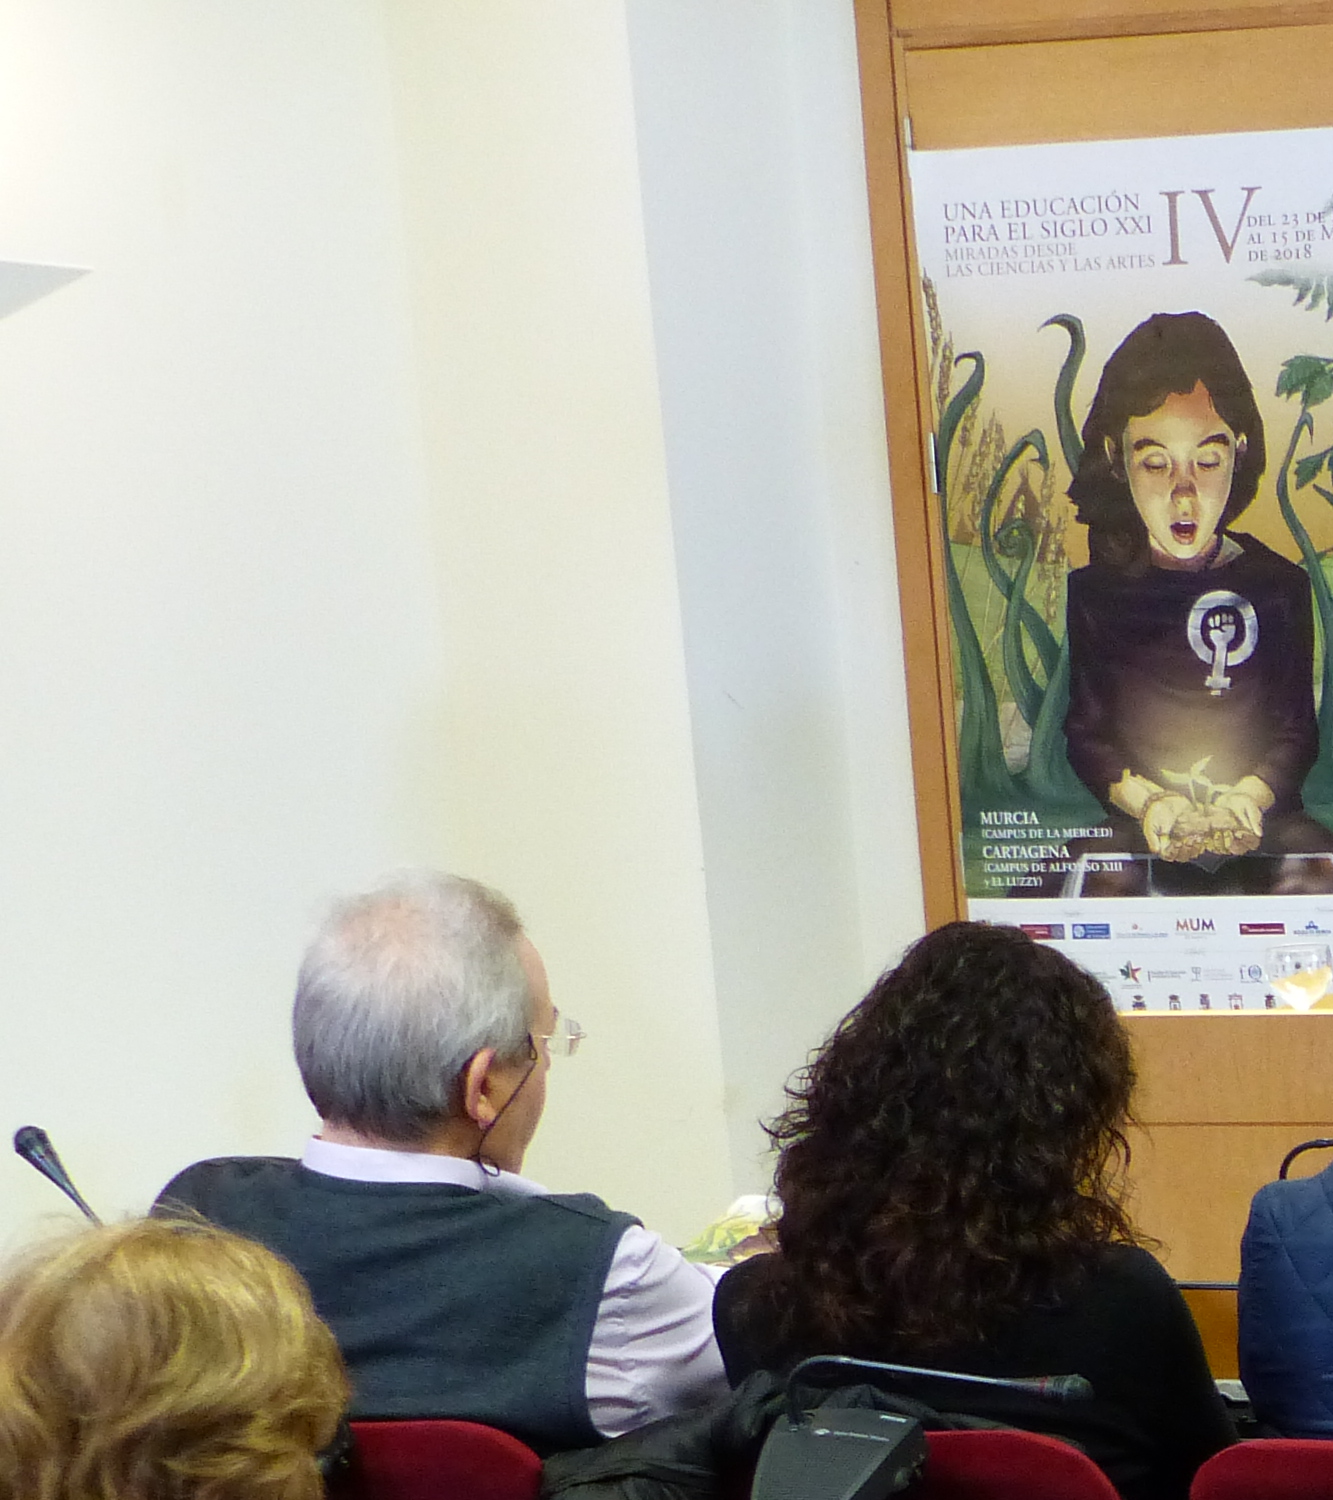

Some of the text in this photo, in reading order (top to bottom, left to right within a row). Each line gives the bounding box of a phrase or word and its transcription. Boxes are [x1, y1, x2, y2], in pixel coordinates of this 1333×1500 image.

[943, 190, 1140, 221] UNA EDUCACIÓN
[1159, 186, 1262, 265] IV
[1282, 213, 1300, 229] 23
[945, 215, 1153, 244] PARA EL SIGLO XXI
[1271, 231, 1288, 246] 15
[945, 242, 1077, 263] MIRADAS DESDE
[1274, 243, 1313, 261] 2018
[946, 254, 1156, 278] LAS CIENCIAS Y LAS ARTES
[980, 811, 1040, 825] MURCIA
[981, 827, 1114, 839] (CAMPUS DE LA MERCED)
[982, 845, 1070, 859] CARTAGENA
[984, 862, 1030, 873] (CAMPUS
[1031, 862, 1048, 872] DE
[1050, 862, 1100, 873] ALFOSO
[1176, 918, 1216, 932] MUM
